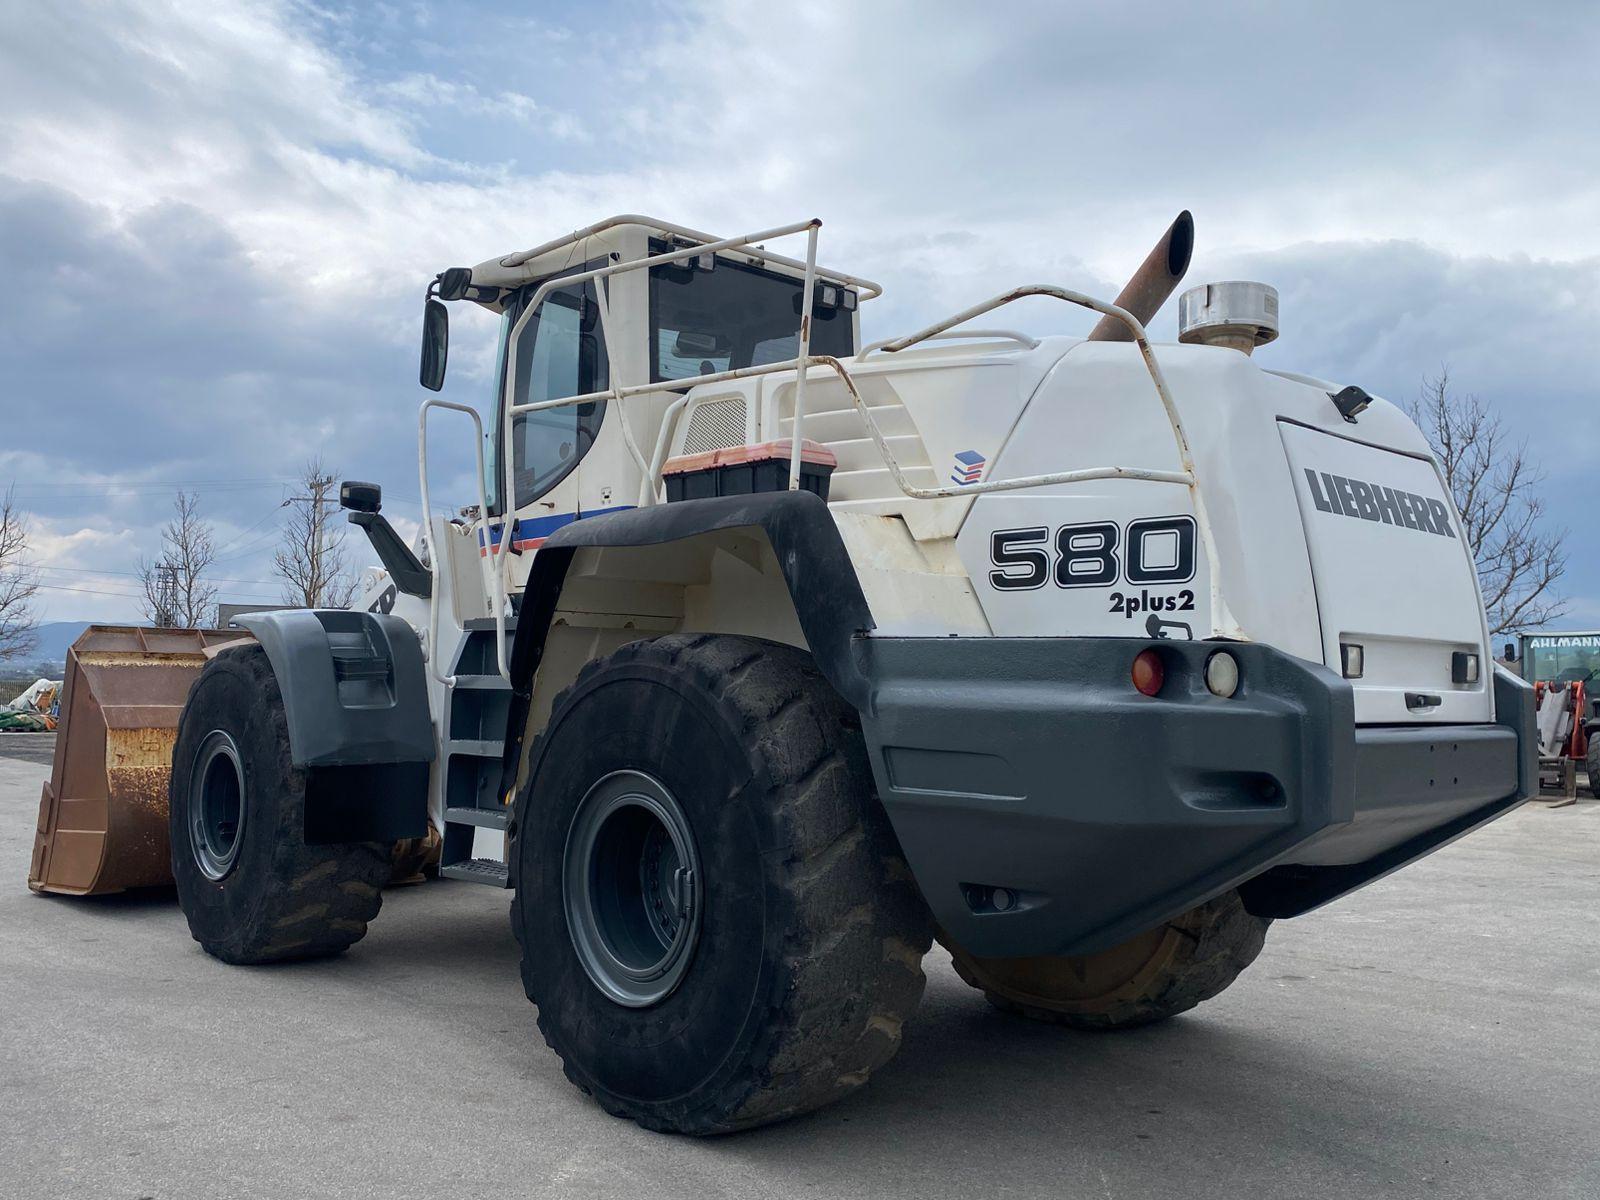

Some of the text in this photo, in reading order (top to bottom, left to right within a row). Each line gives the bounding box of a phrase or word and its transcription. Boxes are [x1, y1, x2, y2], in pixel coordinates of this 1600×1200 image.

[1304, 468, 1457, 538] LIEBHERR
[989, 514, 1197, 591] 580
[1108, 589, 1195, 618] 2plus2
[1530, 636, 1600, 648] AHLMANN
